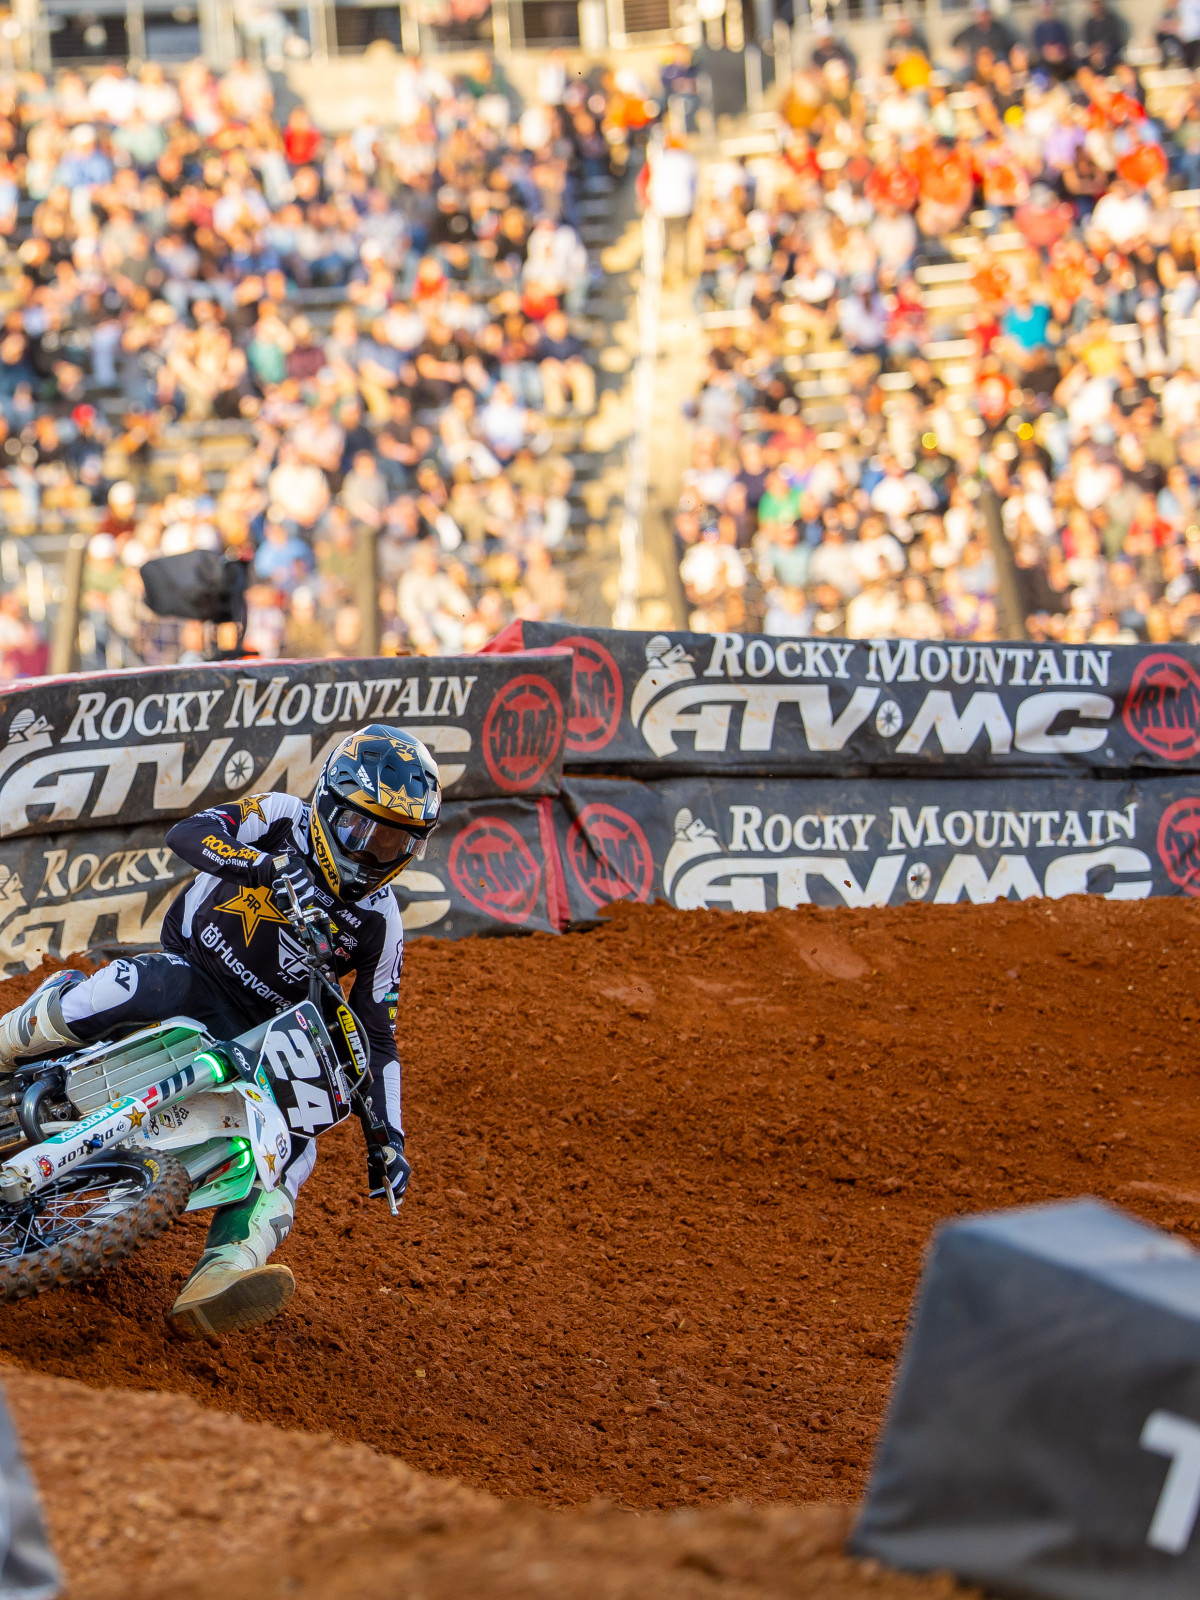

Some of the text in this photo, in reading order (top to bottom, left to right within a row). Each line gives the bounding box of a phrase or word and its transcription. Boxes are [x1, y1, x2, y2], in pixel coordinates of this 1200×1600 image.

[703, 633, 1112, 686] ROCKY MOUNTAIN
[60, 676, 478, 744] ROCKY MOUNTAIN
[500, 709, 552, 758] RM
[728, 802, 1138, 852] ROCKY MOUNTAIN
[36, 848, 175, 902] ROCKY
[202, 848, 225, 866] ENERG
[214, 939, 292, 1007] Husqvarna
[264, 1029, 334, 1134] 24
[60, 1107, 114, 1141] MOTOREX
